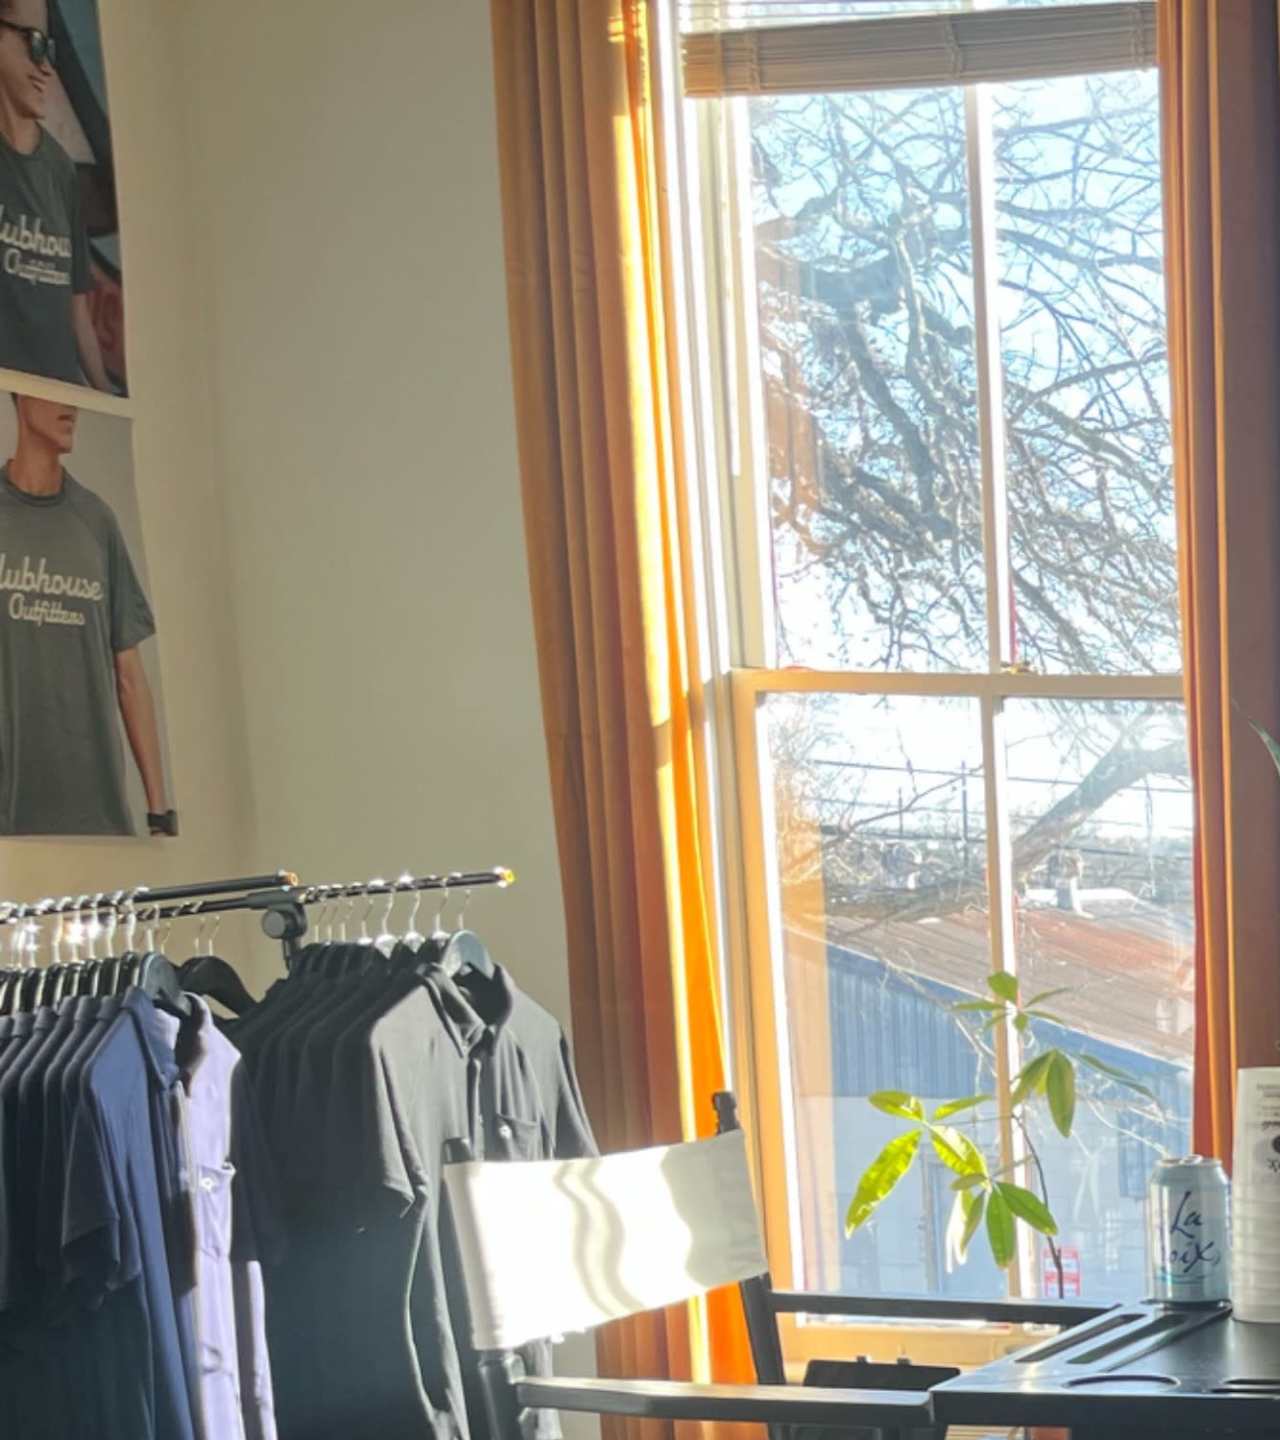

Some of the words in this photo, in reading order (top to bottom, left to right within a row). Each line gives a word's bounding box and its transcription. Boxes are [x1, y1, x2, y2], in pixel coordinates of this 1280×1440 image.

[0, 553, 104, 601] lubhouse
[9, 592, 86, 627] Outfitters
[1170, 1190, 1203, 1239] La
